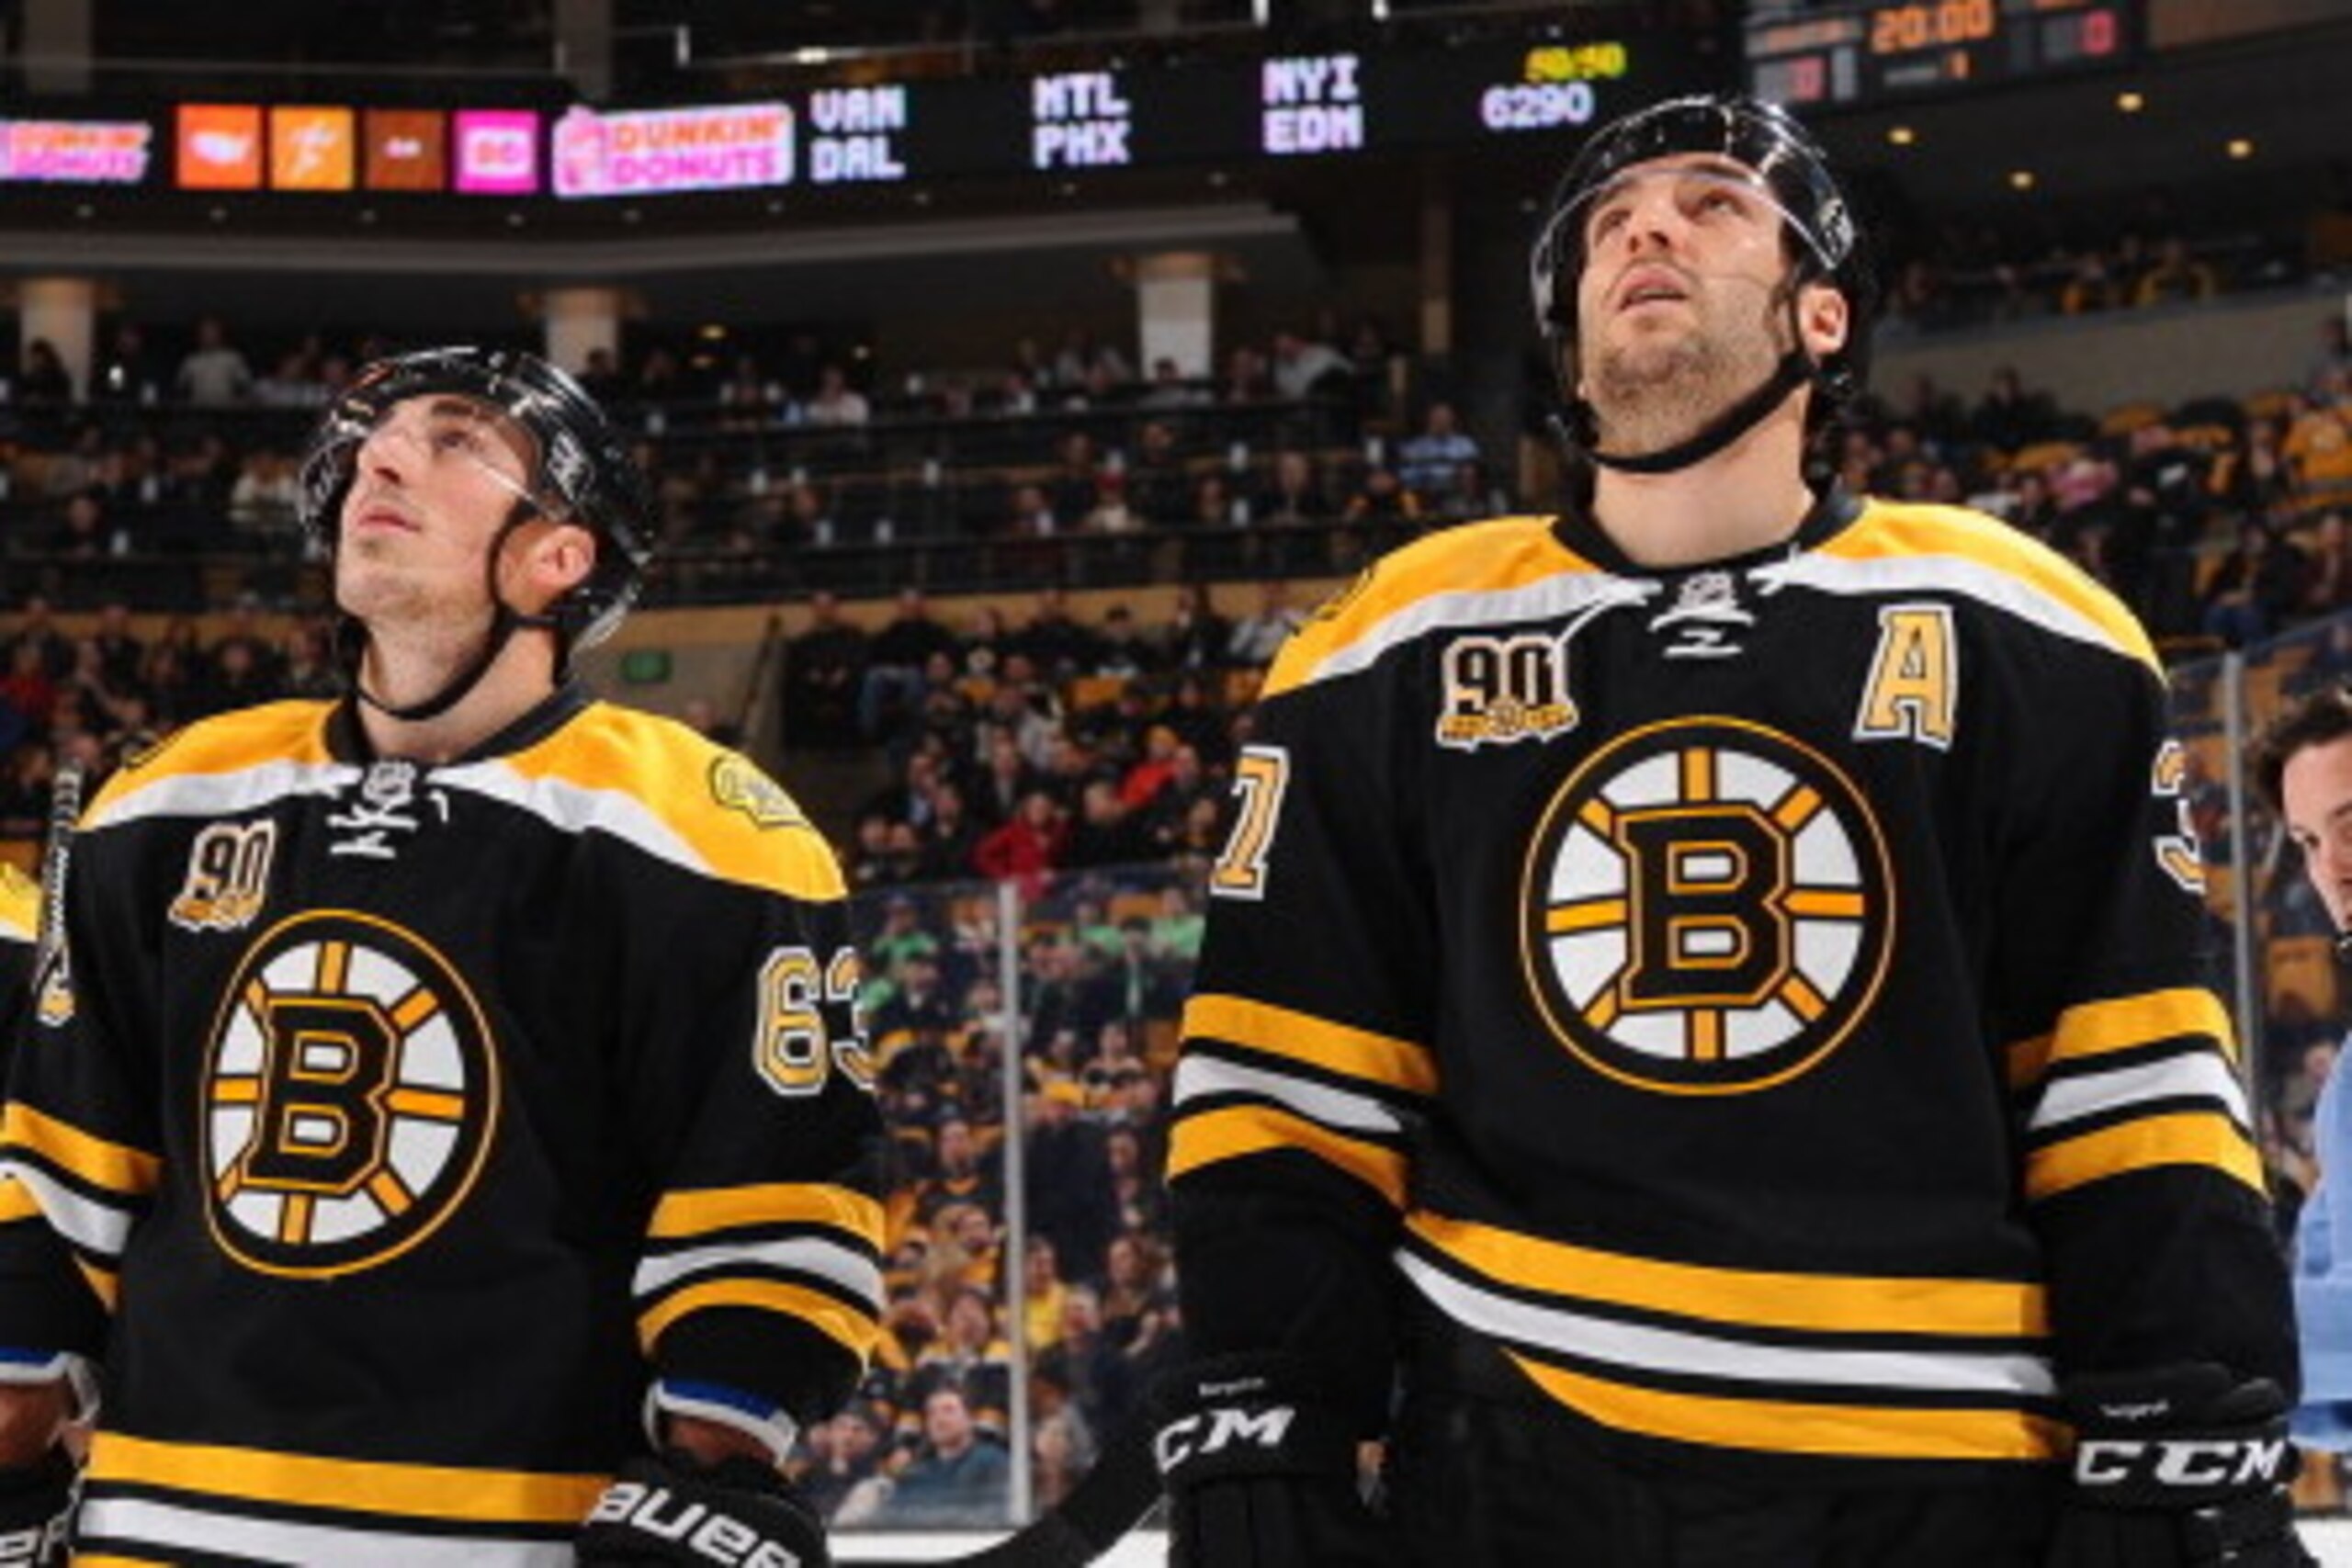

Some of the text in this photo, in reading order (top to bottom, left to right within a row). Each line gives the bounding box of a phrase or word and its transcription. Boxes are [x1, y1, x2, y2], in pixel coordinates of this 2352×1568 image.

[1871, 0, 1994, 53] 20:00
[1034, 73, 1130, 119] MTL
[1263, 55, 1359, 102] NYI
[810, 87, 906, 131] VAN
[1263, 105, 1363, 153] EDM
[1481, 85, 1594, 129] 6290
[612, 145, 777, 185] DONUTS
[810, 136, 906, 182] DAL
[1034, 121, 1131, 169] PHX
[1442, 634, 1567, 716] 90
[1854, 603, 1960, 751] A
[184, 818, 276, 902] 90
[1617, 802, 1794, 1013] B
[242, 996, 399, 1197] B
[2076, 1438, 2285, 1486] CCM
